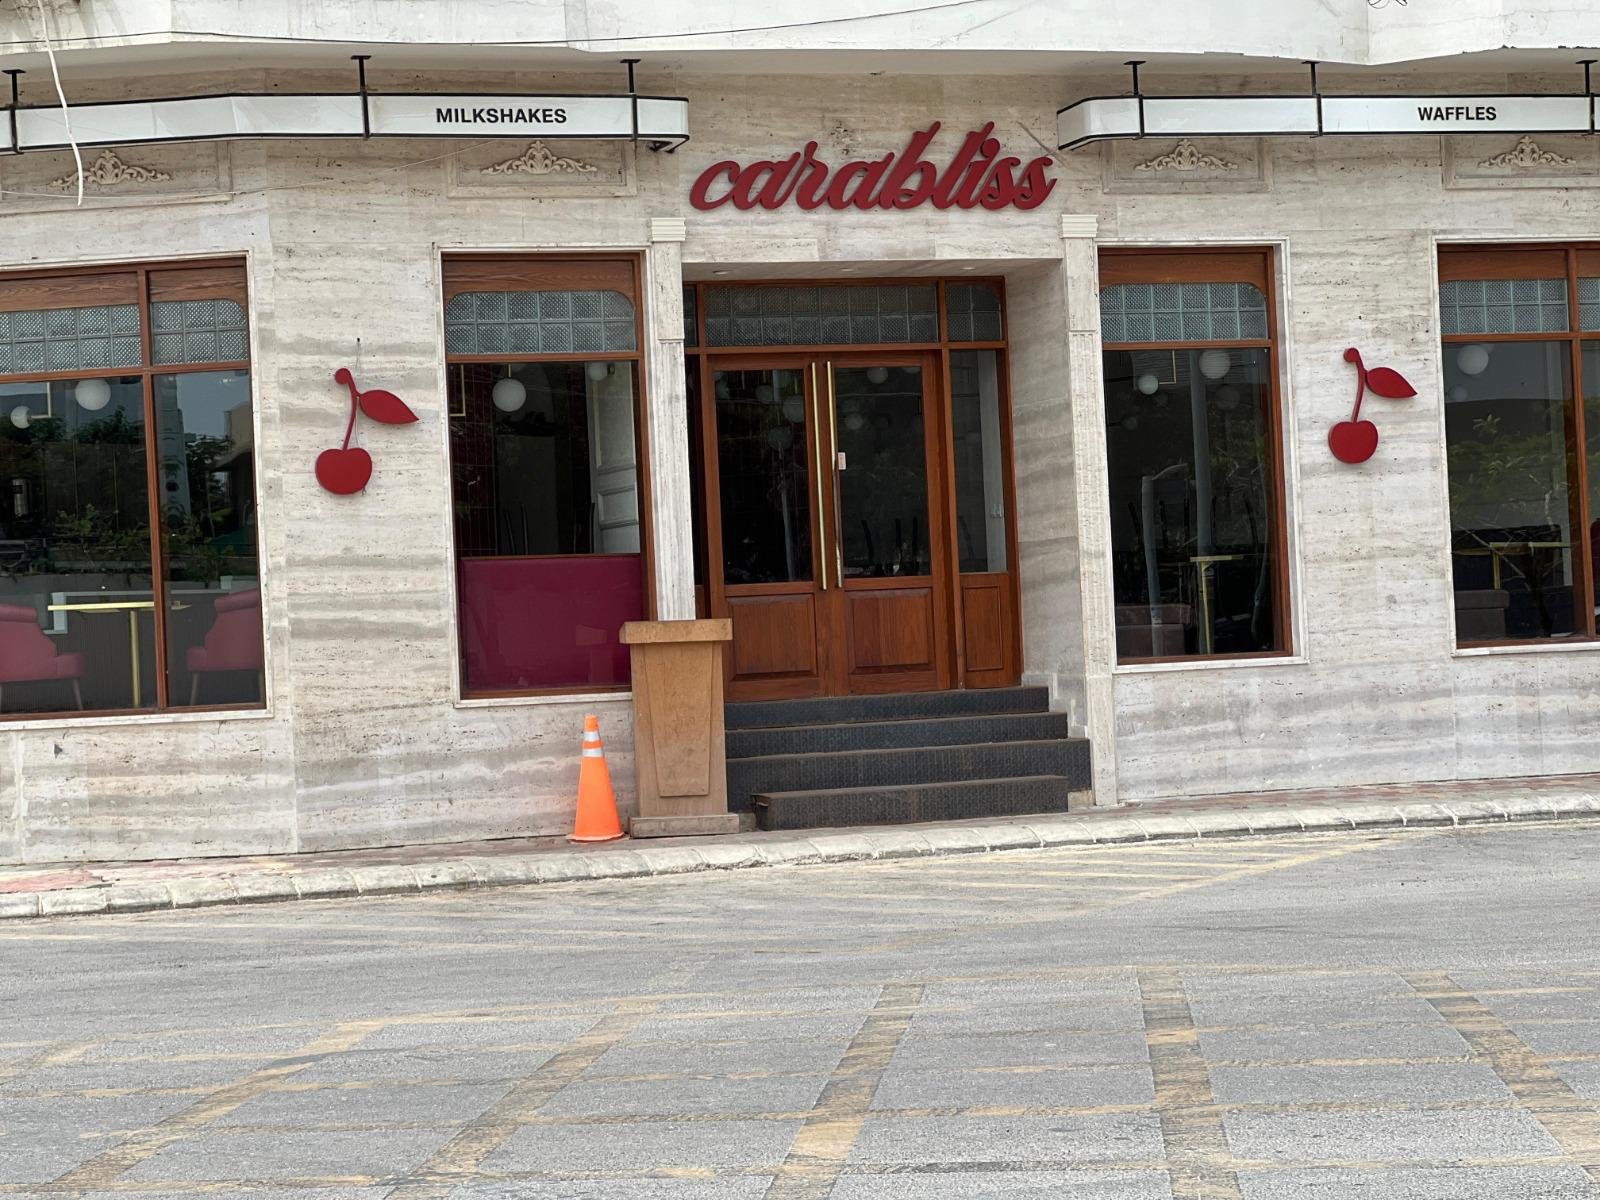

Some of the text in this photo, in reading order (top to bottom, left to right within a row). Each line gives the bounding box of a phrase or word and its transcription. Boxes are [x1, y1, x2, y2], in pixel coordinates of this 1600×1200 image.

[436, 108, 567, 124] MILKSHAKES
[1418, 107, 1497, 121] WAFFLES
[689, 121, 1057, 211] carabliss
